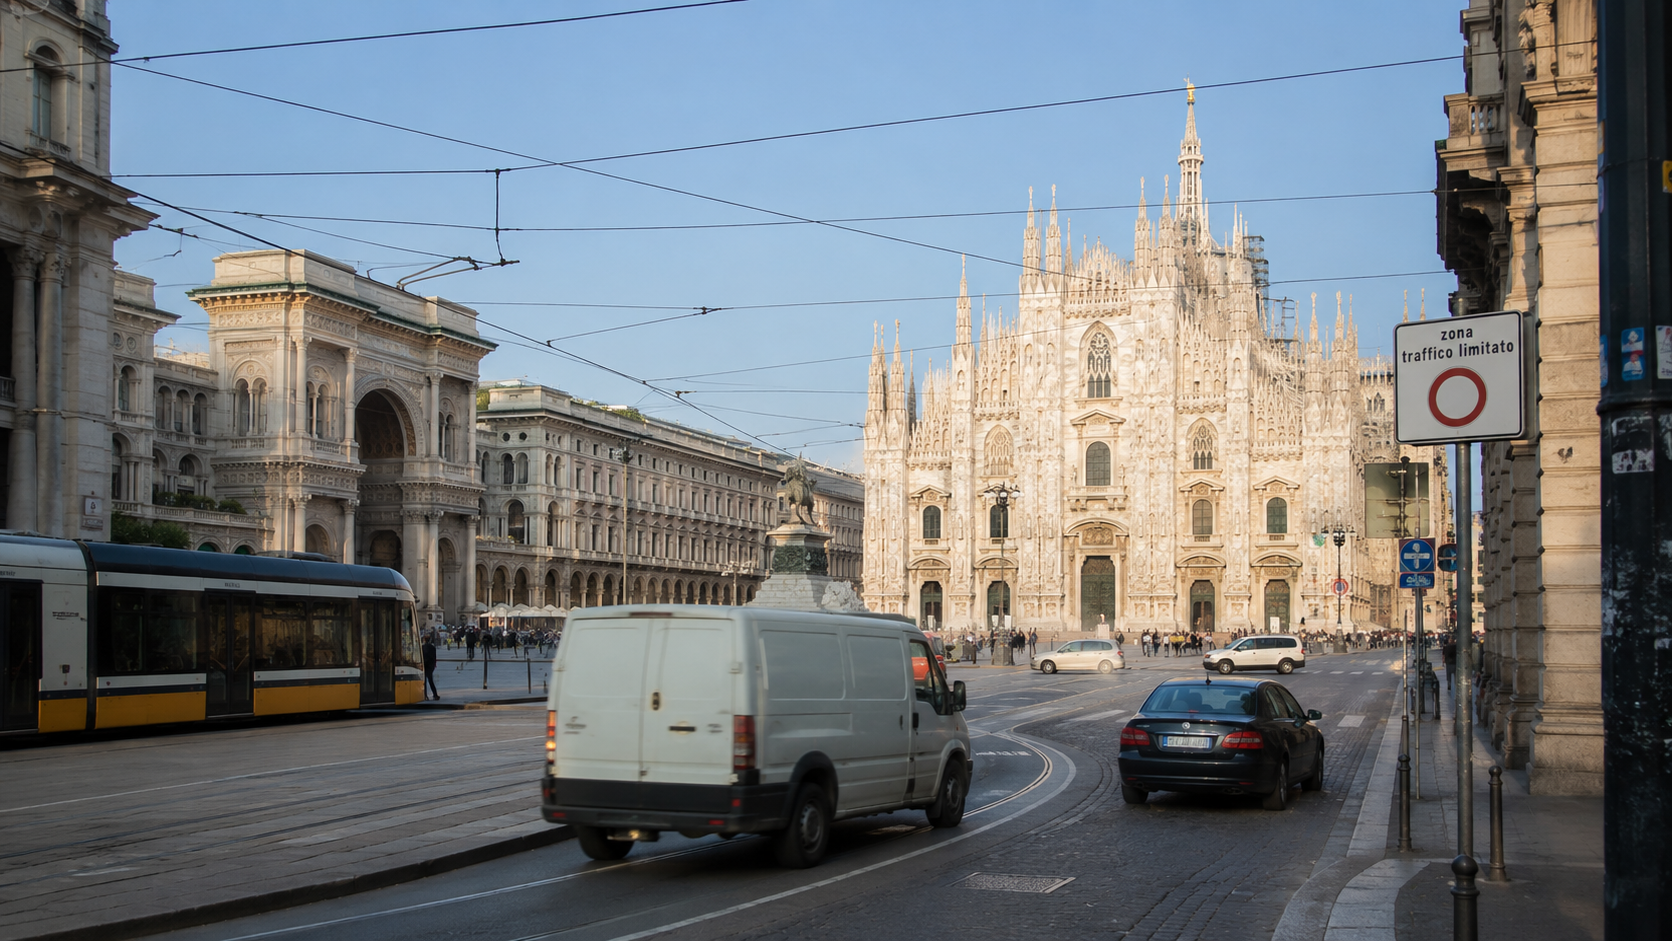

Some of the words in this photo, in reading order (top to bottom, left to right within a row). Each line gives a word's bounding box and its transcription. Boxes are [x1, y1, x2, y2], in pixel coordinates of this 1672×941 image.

[1441, 328, 1473, 341] zona
[1402, 347, 1453, 363] traffico
[1459, 340, 1514, 357] limitato
